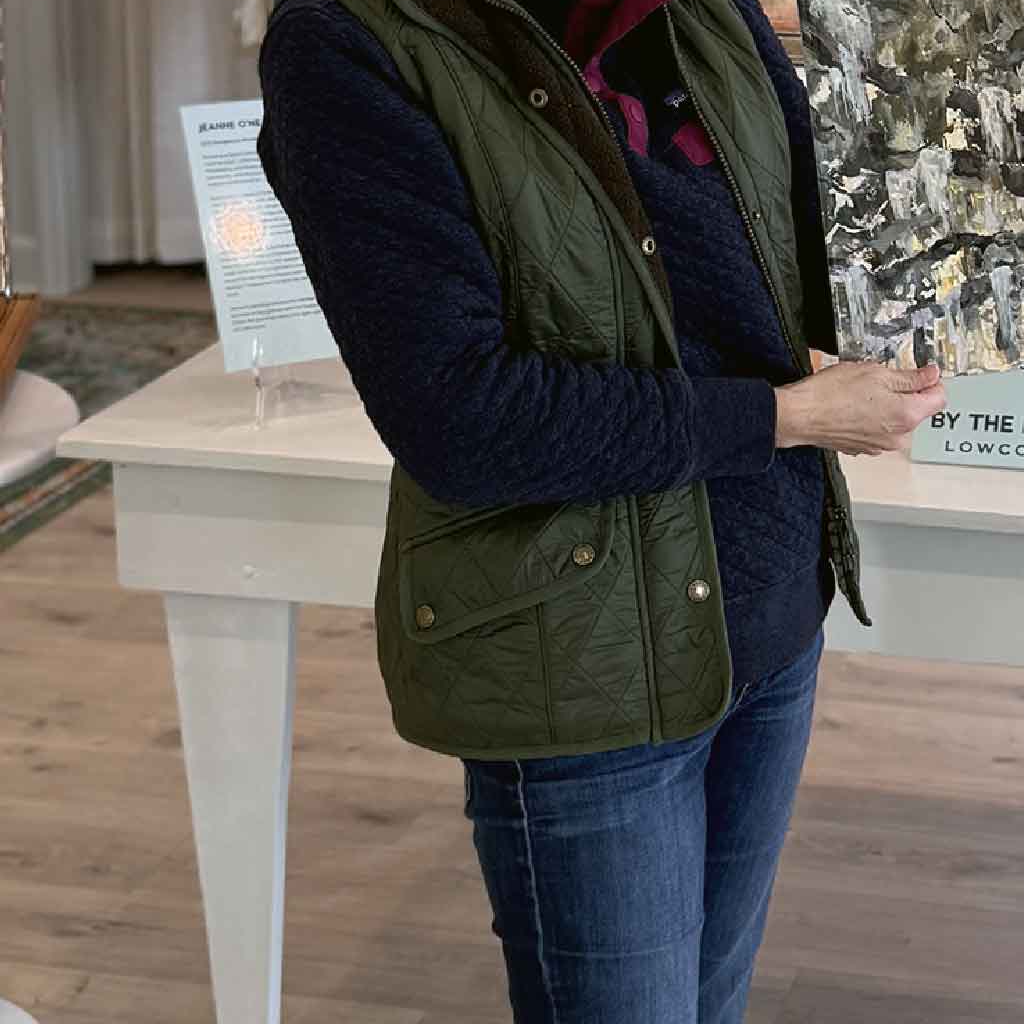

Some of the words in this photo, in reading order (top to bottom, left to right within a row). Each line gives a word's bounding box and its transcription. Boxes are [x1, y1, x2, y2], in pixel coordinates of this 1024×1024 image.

[199, 121, 235, 133] JEANNE
[931, 412, 960, 430] BY
[969, 413, 1014, 433] THE
